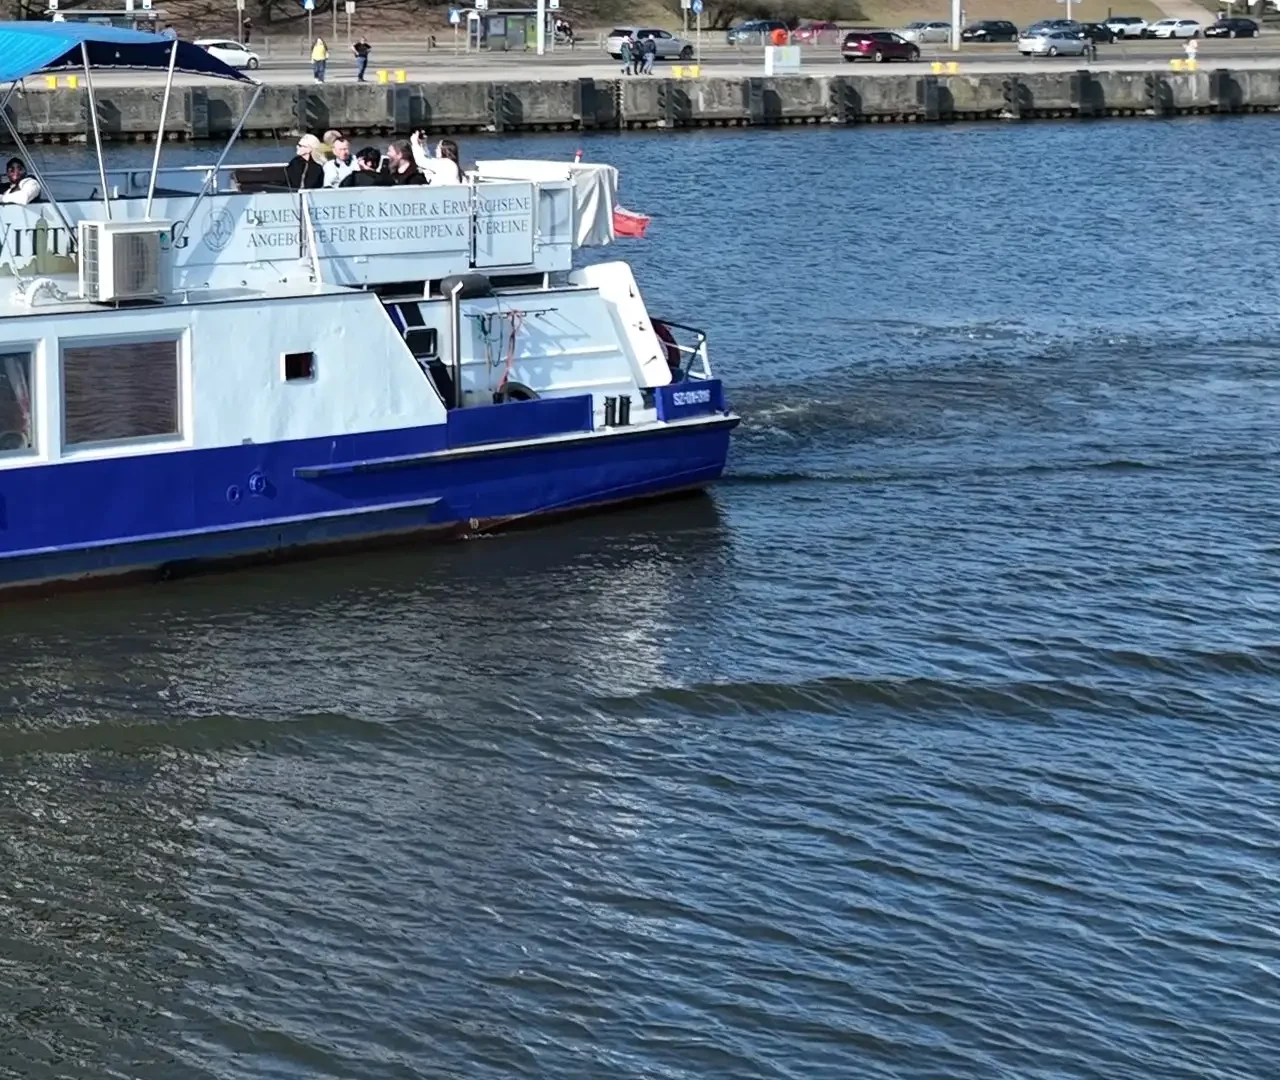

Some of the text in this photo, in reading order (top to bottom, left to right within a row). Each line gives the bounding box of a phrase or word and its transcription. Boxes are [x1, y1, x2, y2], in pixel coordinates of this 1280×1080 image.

[349, 201, 375, 219] FÜR
[378, 201, 427, 217] KINDER
[429, 202, 439, 215] &
[247, 219, 529, 248] ANGEBE FÜR REISEGRUPPEN & VEREINE
